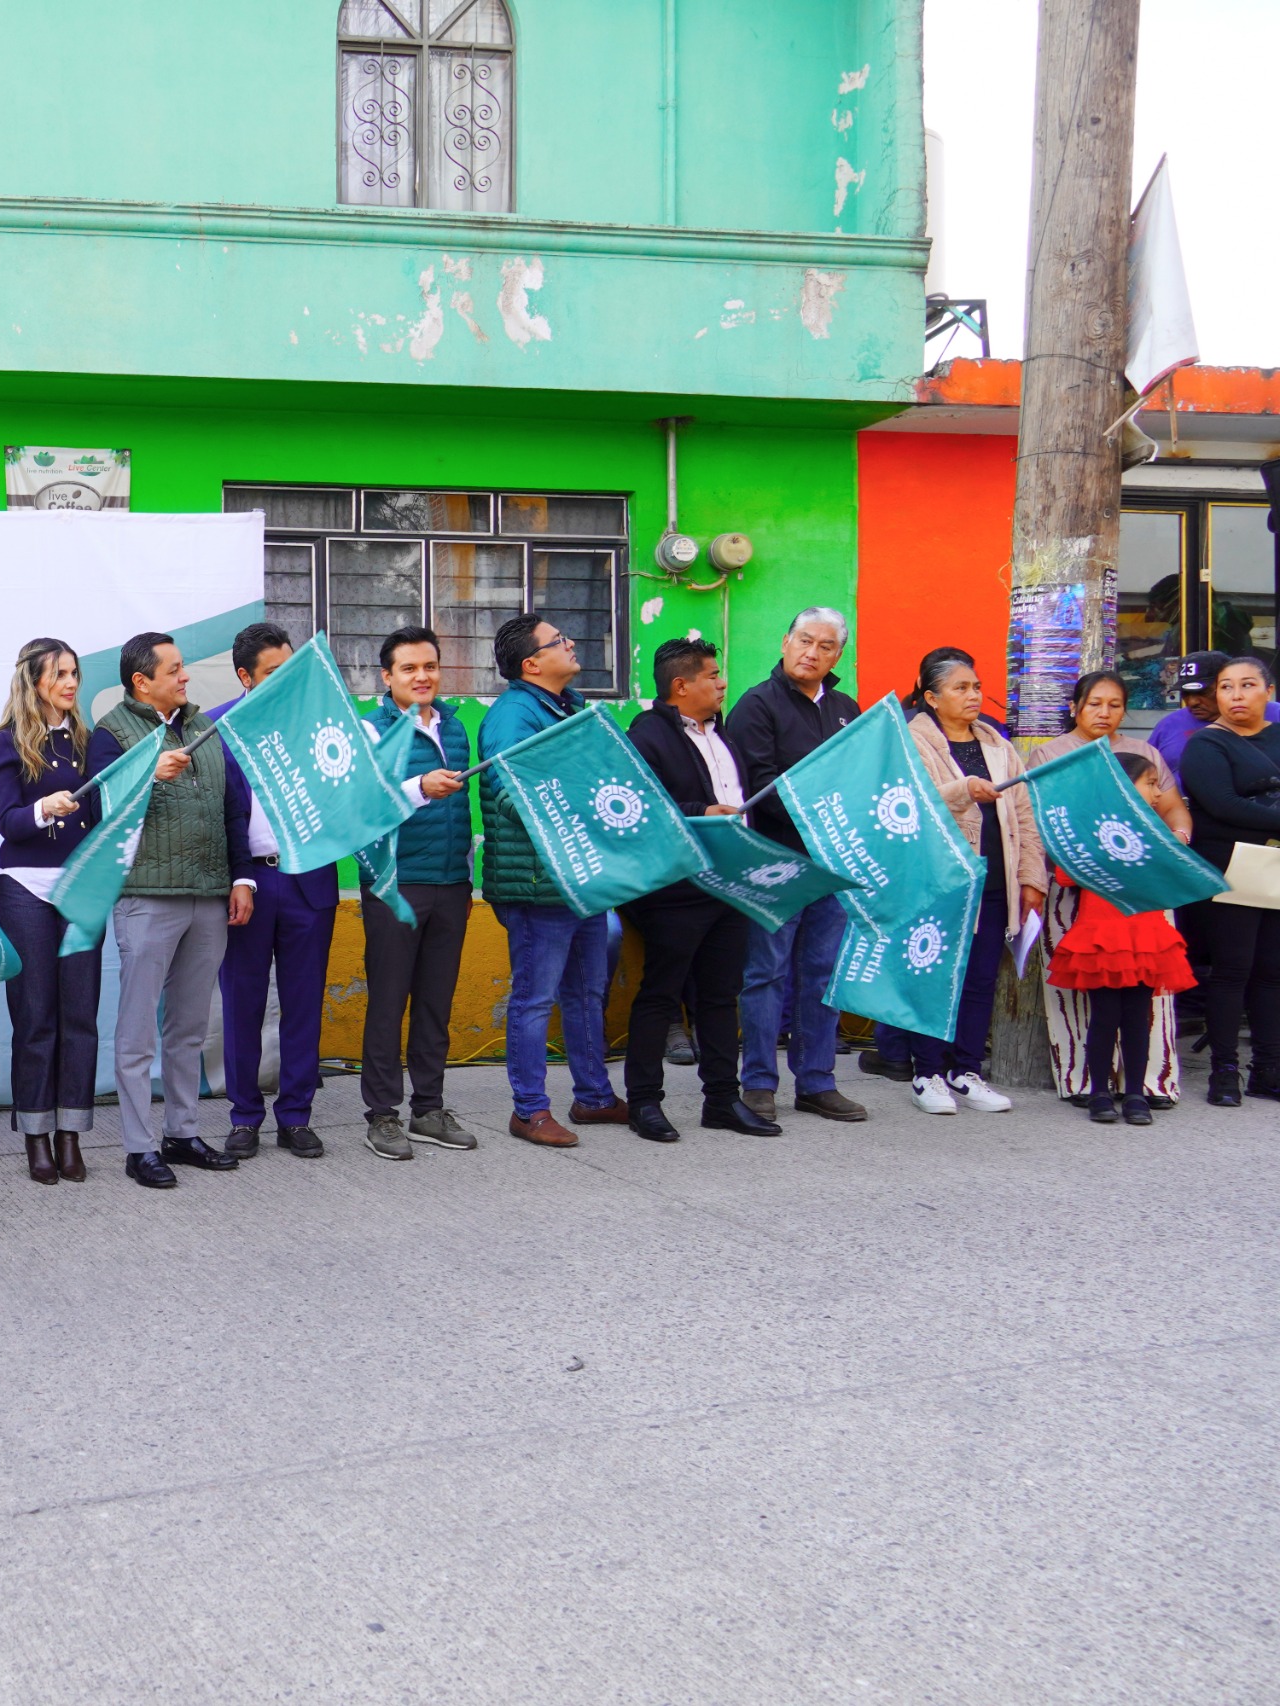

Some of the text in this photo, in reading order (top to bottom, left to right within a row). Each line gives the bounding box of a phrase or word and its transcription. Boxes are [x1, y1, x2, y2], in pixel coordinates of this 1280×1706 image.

[48, 490, 68, 501] live
[1180, 663, 1197, 676] 23
[256, 735, 313, 846] Texmelucan
[268, 729, 324, 835] San Martín
[547, 777, 604, 876] San Martín
[1055, 805, 1077, 842] San
[533, 780, 590, 887] Texmelucan
[826, 791, 890, 889] San Martín
[1045, 804, 1118, 892] Texmelucan
